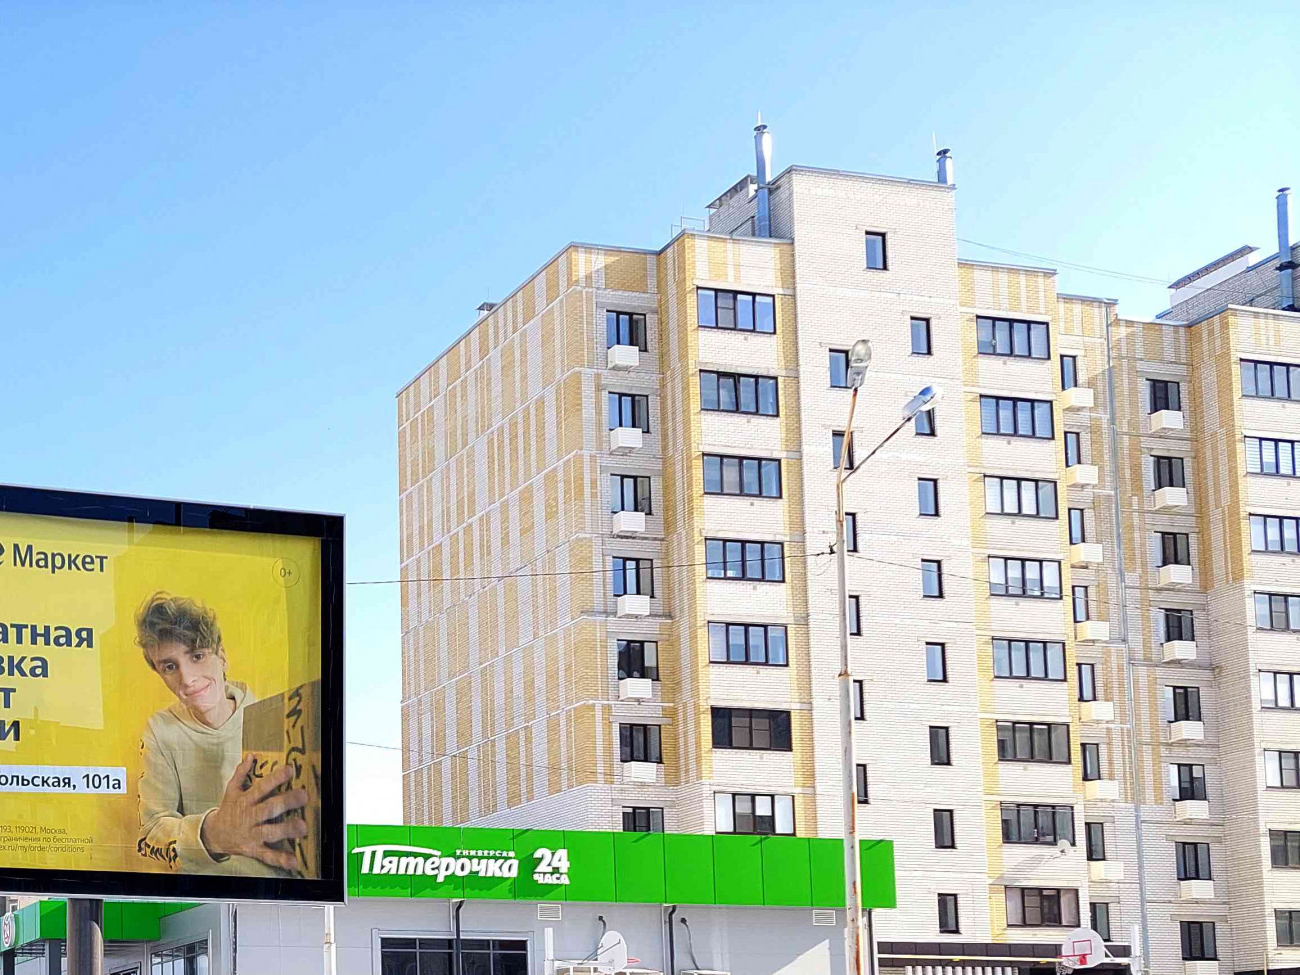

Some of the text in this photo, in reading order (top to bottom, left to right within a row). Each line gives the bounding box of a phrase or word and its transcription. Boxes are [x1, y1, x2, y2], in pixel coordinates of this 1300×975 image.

[12, 542, 108, 574] Маркет
[279, 567, 292, 578] 0+
[82, 773, 122, 790] 101а
[40, 826, 68, 836] Москва,
[53, 835, 94, 845] бесплатной
[455, 849, 515, 858] УНИВЕРСАМ
[532, 847, 570, 874] 24
[532, 873, 570, 885] ЧАСА
